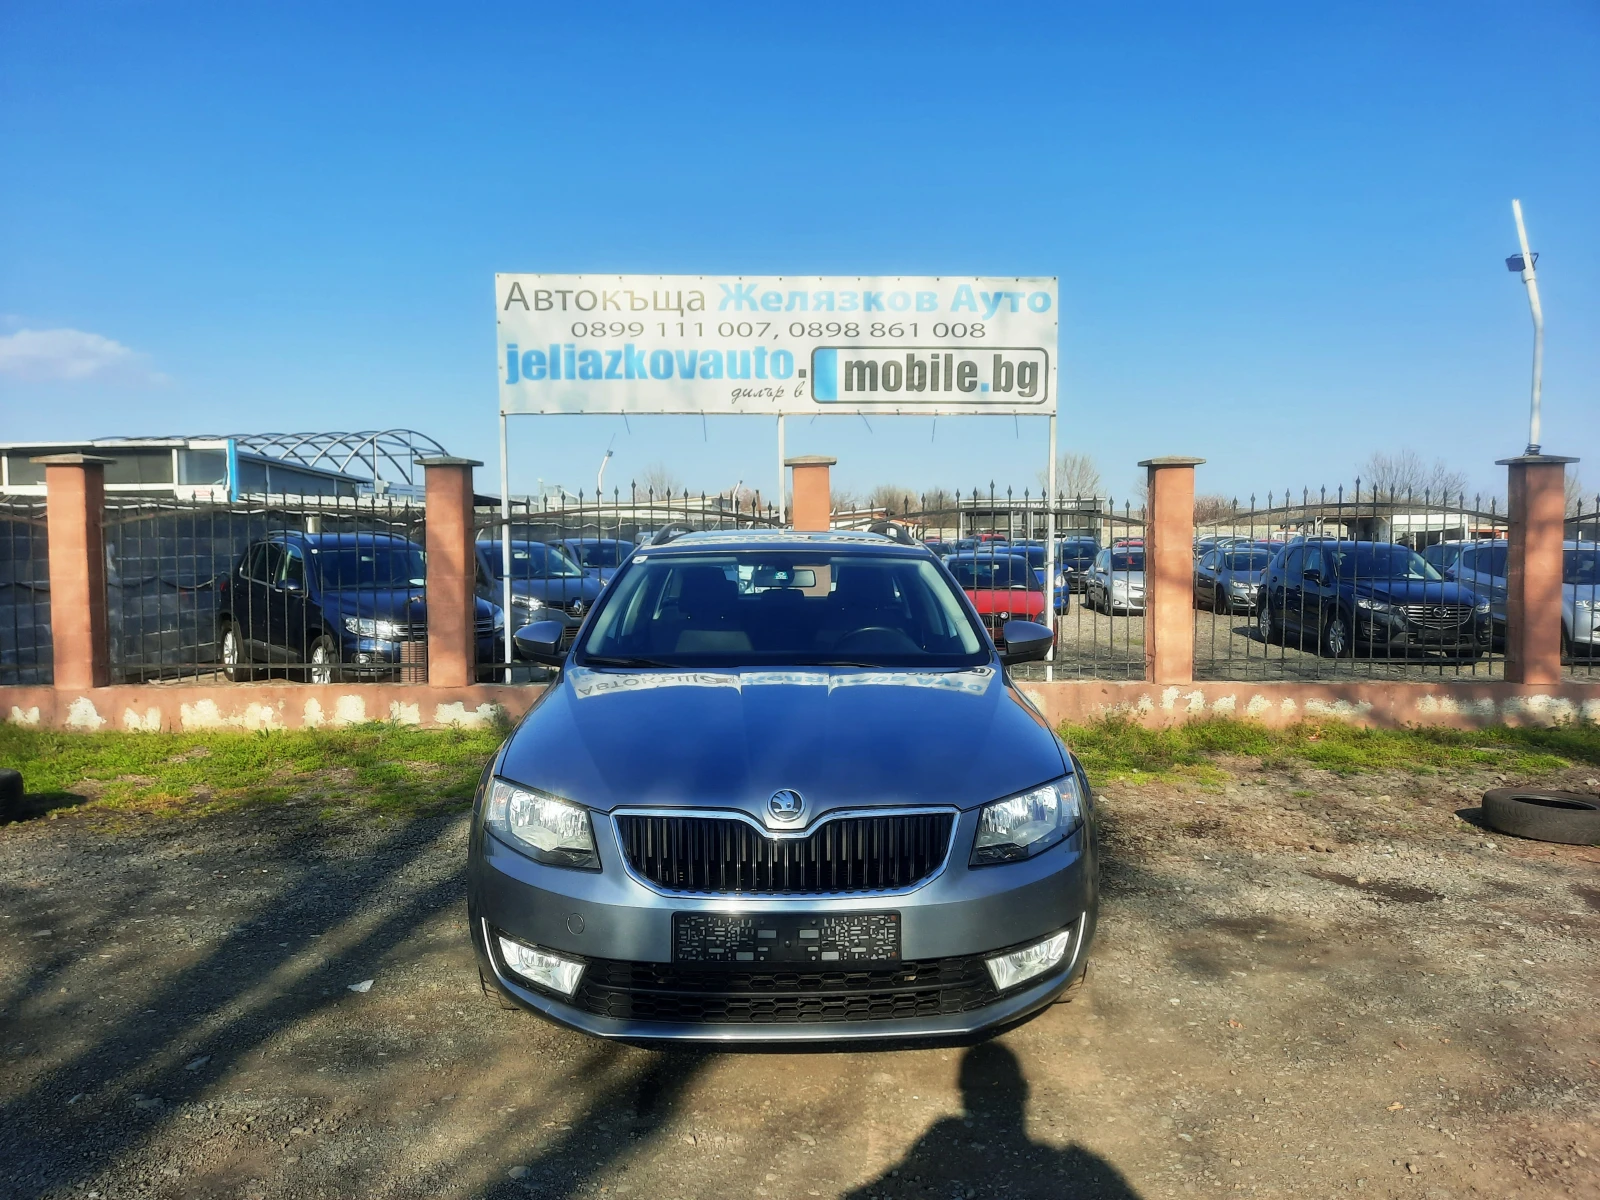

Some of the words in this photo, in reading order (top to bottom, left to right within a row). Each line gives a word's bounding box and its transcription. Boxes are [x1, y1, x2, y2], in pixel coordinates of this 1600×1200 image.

[503, 281, 706, 318] Автокъща
[717, 283, 939, 313] Желязков
[950, 283, 1052, 321] Ауто
[571, 321, 645, 338] 0899
[656, 322, 704, 337] 111
[717, 321, 780, 340] 007,
[788, 322, 861, 338] 0898
[869, 322, 919, 338] 861
[932, 322, 986, 338] 008
[844, 353, 1039, 398] mobile.bg
[731, 385, 785, 404] дилър
